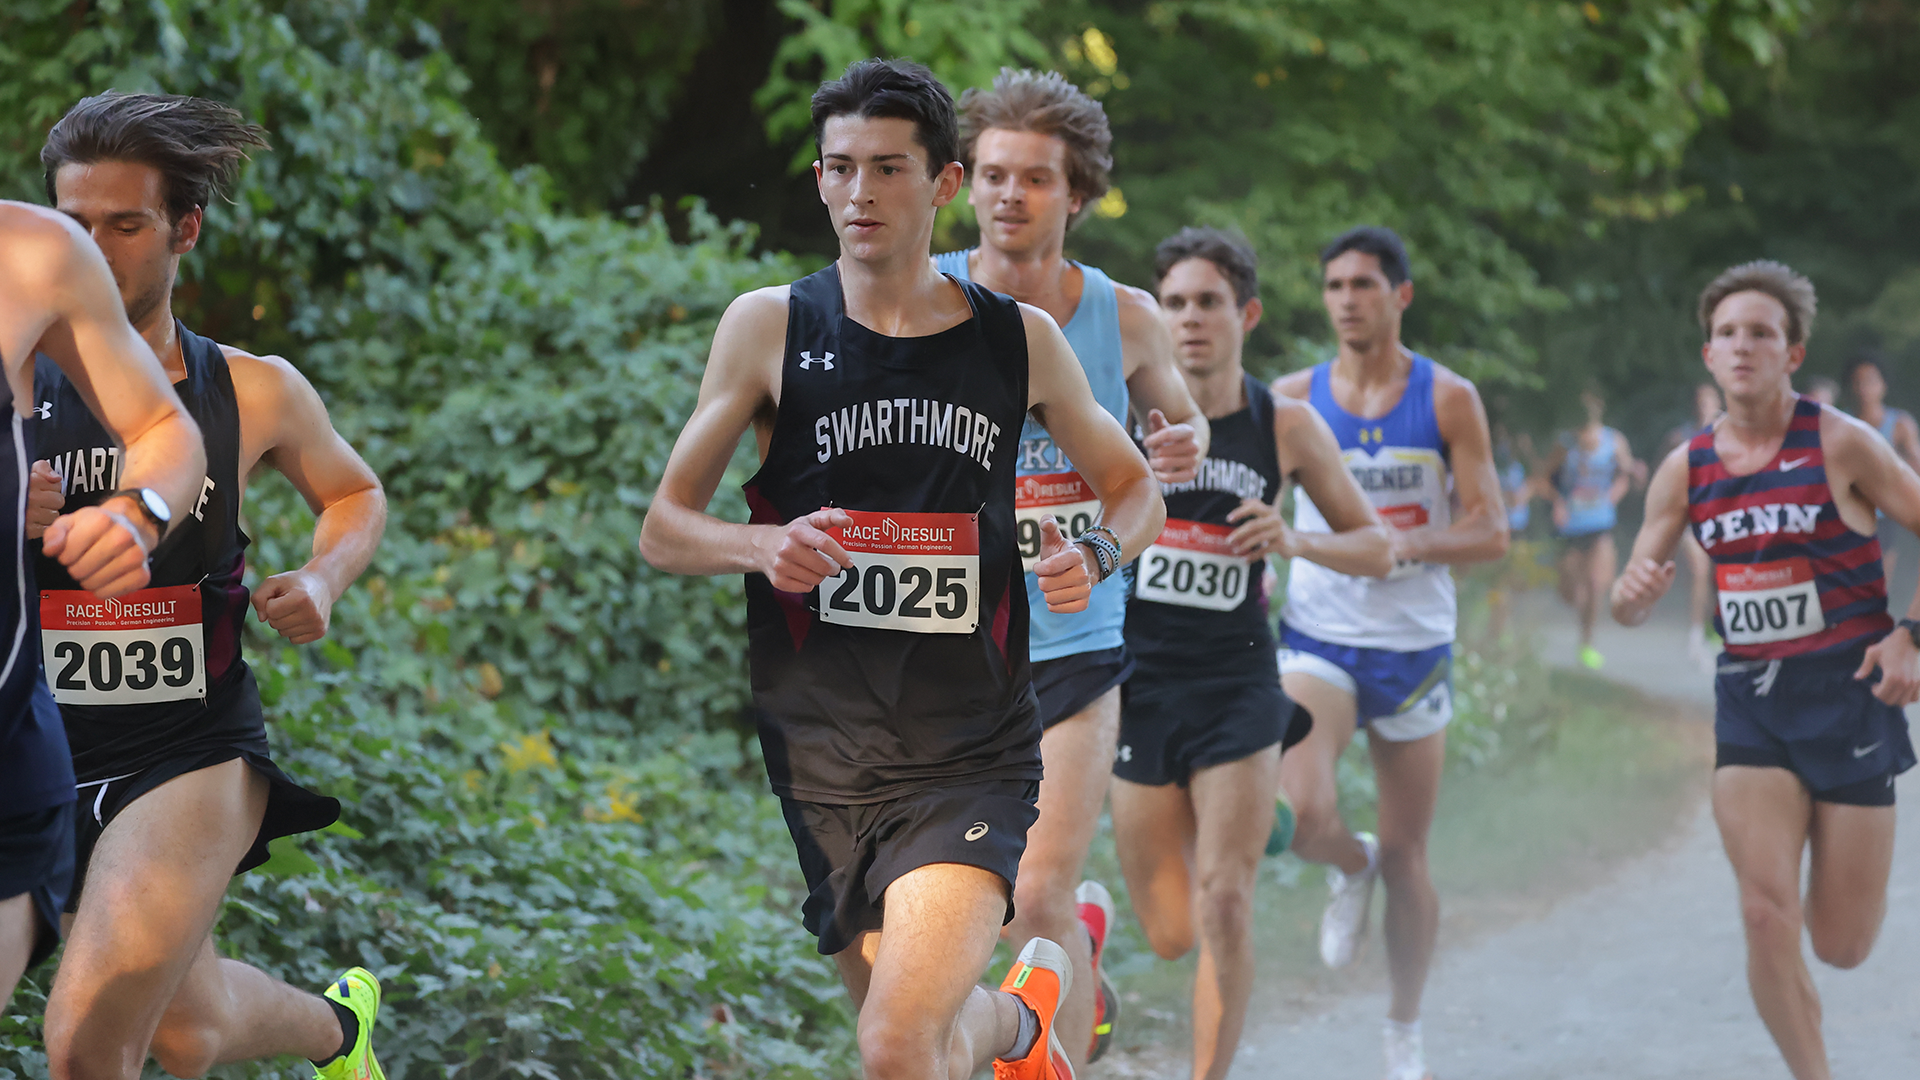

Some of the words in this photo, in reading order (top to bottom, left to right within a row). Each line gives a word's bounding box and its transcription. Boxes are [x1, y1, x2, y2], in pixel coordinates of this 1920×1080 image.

[815, 398, 1001, 472] SWARTHMORE
[842, 526, 880, 541] RACE
[901, 528, 955, 542] RESULT
[829, 564, 968, 620] 2025
[1147, 556, 1241, 600] 2030
[66, 604, 103, 618] RACE
[124, 600, 177, 617] RESULT
[143, 616, 175, 625] Engineering
[1727, 594, 1808, 632] 2007
[54, 637, 195, 692] 2039
